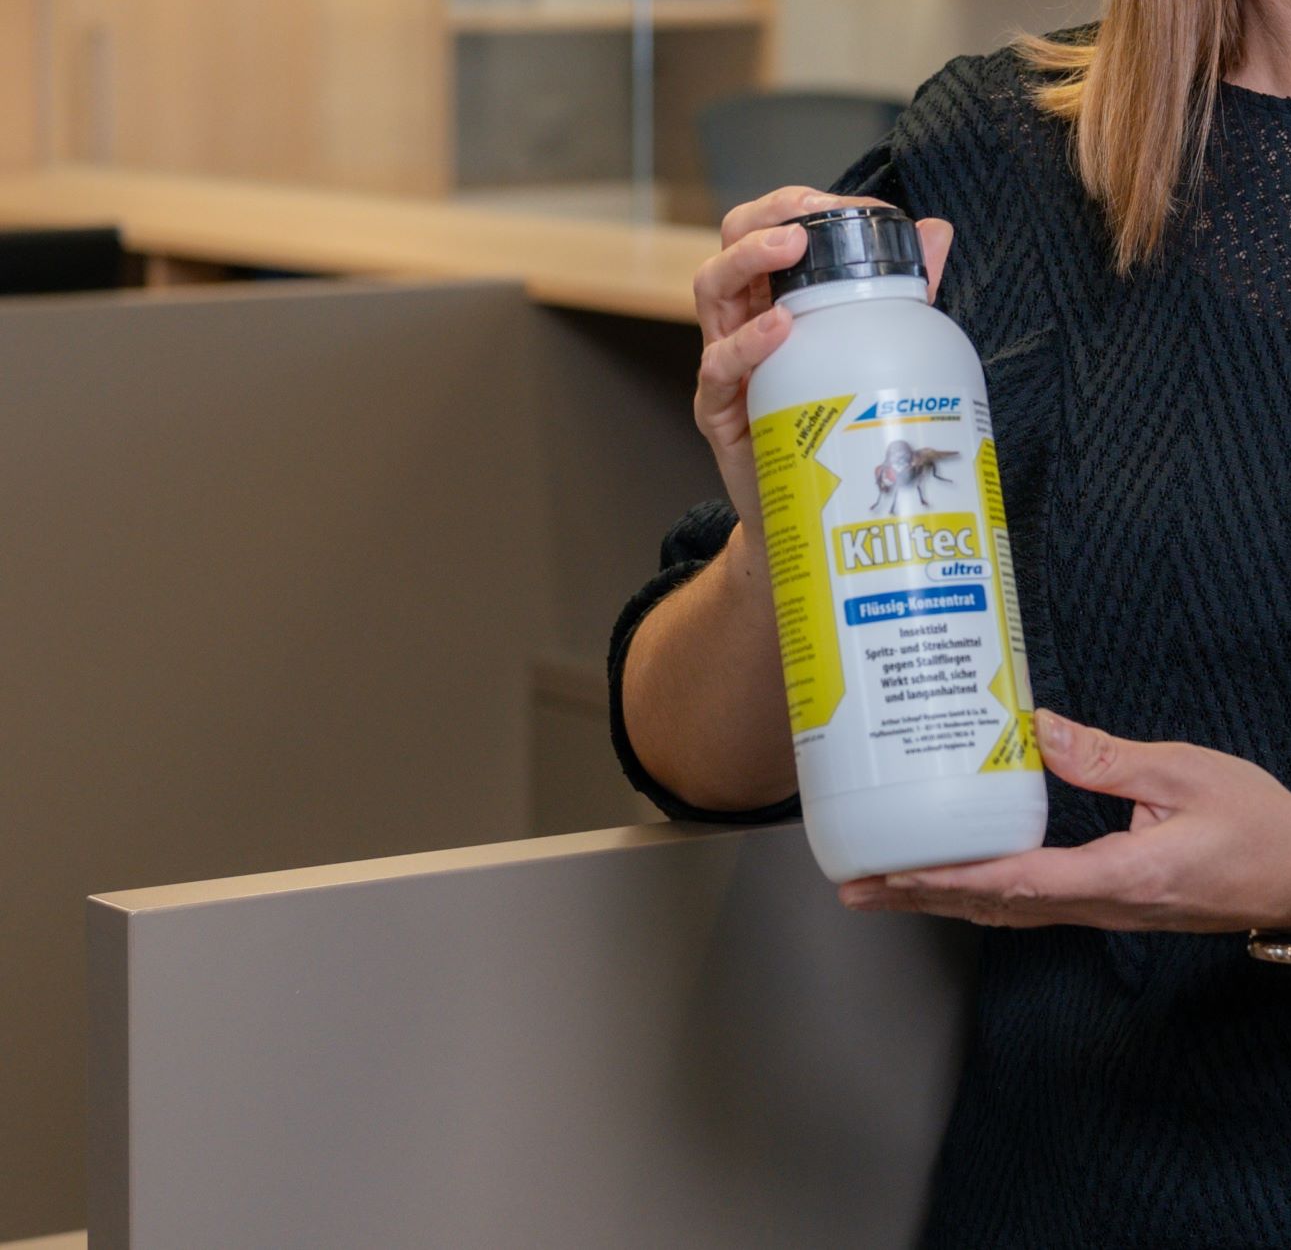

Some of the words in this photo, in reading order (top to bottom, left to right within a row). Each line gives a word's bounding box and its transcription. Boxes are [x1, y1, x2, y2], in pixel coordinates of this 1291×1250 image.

[881, 397, 962, 414] SCHOPF
[799, 405, 826, 440] Wochen
[841, 523, 975, 570] Killtec
[941, 562, 983, 576] ultra
[859, 593, 976, 618] Flüssig-Konzentrat
[899, 623, 948, 638] Insektizid
[865, 647, 898, 661] Spritz-
[900, 643, 920, 655] und
[922, 636, 982, 651] Streichmittel
[882, 660, 914, 674] gegen
[916, 653, 971, 667] Stallfliegen
[881, 675, 909, 688] Wirkt
[911, 670, 949, 684] schnell,
[950, 668, 977, 680] sicher
[885, 691, 905, 703] und
[906, 683, 978, 700] langanhaltend
